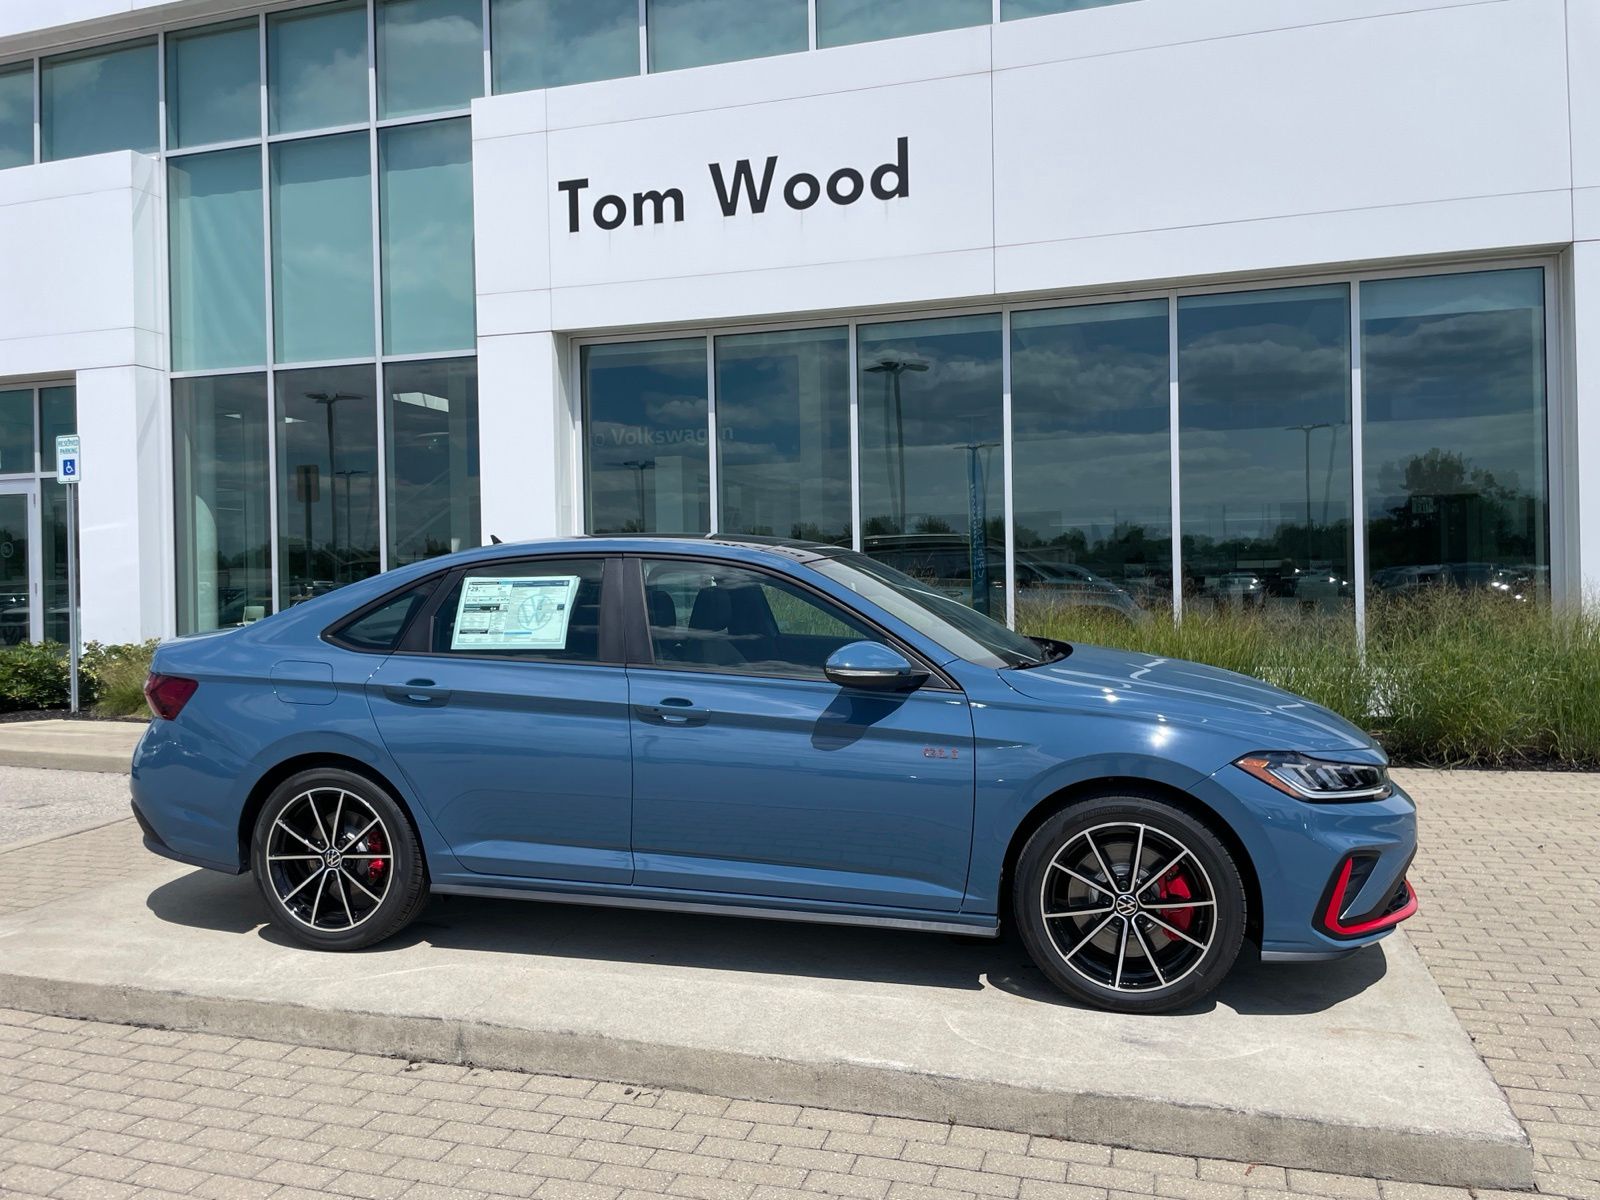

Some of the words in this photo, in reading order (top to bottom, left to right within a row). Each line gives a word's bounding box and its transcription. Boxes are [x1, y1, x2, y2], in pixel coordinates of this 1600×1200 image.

[558, 178, 685, 233] Tom
[708, 136, 909, 217] Wood
[611, 425, 734, 446] Volkswagn
[60, 447, 78, 455] PARKING
